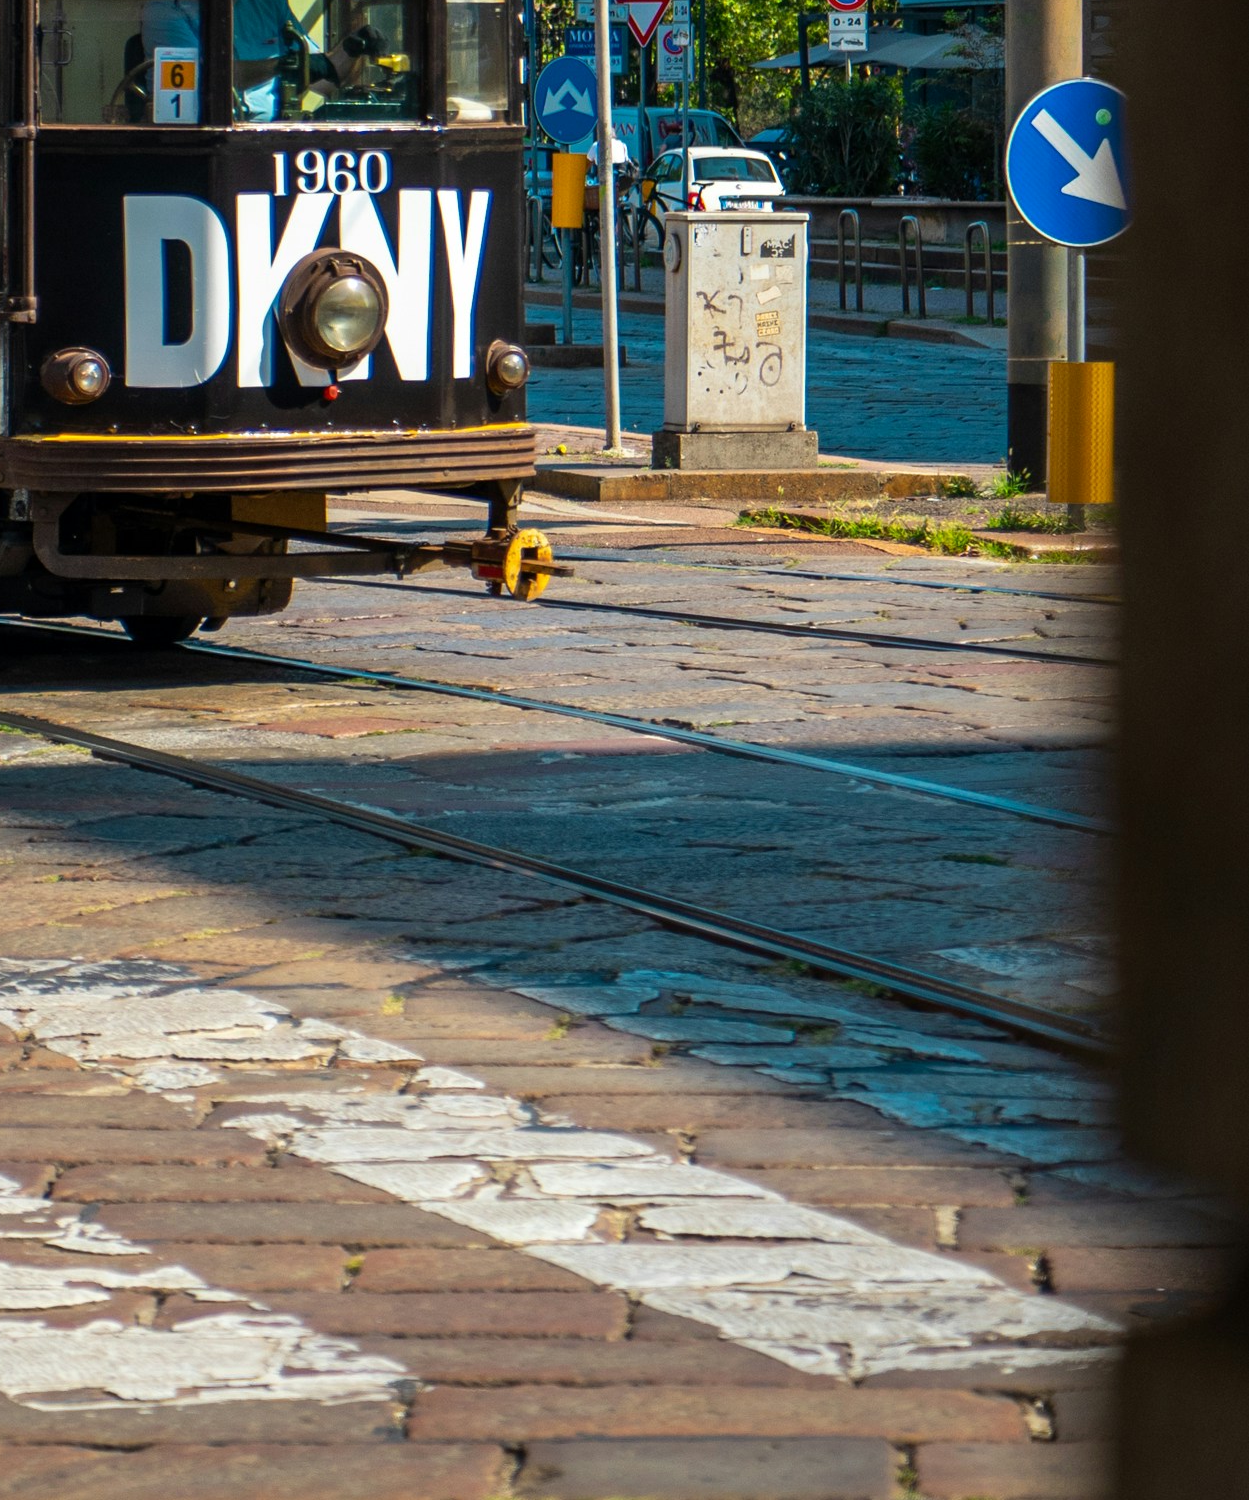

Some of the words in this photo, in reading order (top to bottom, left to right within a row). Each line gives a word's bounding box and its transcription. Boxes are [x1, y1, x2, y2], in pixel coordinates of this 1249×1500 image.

[170, 63, 184, 88] 6
[170, 93, 181, 119] 1
[273, 149, 392, 197] 1960
[123, 188, 492, 390] DKNY
